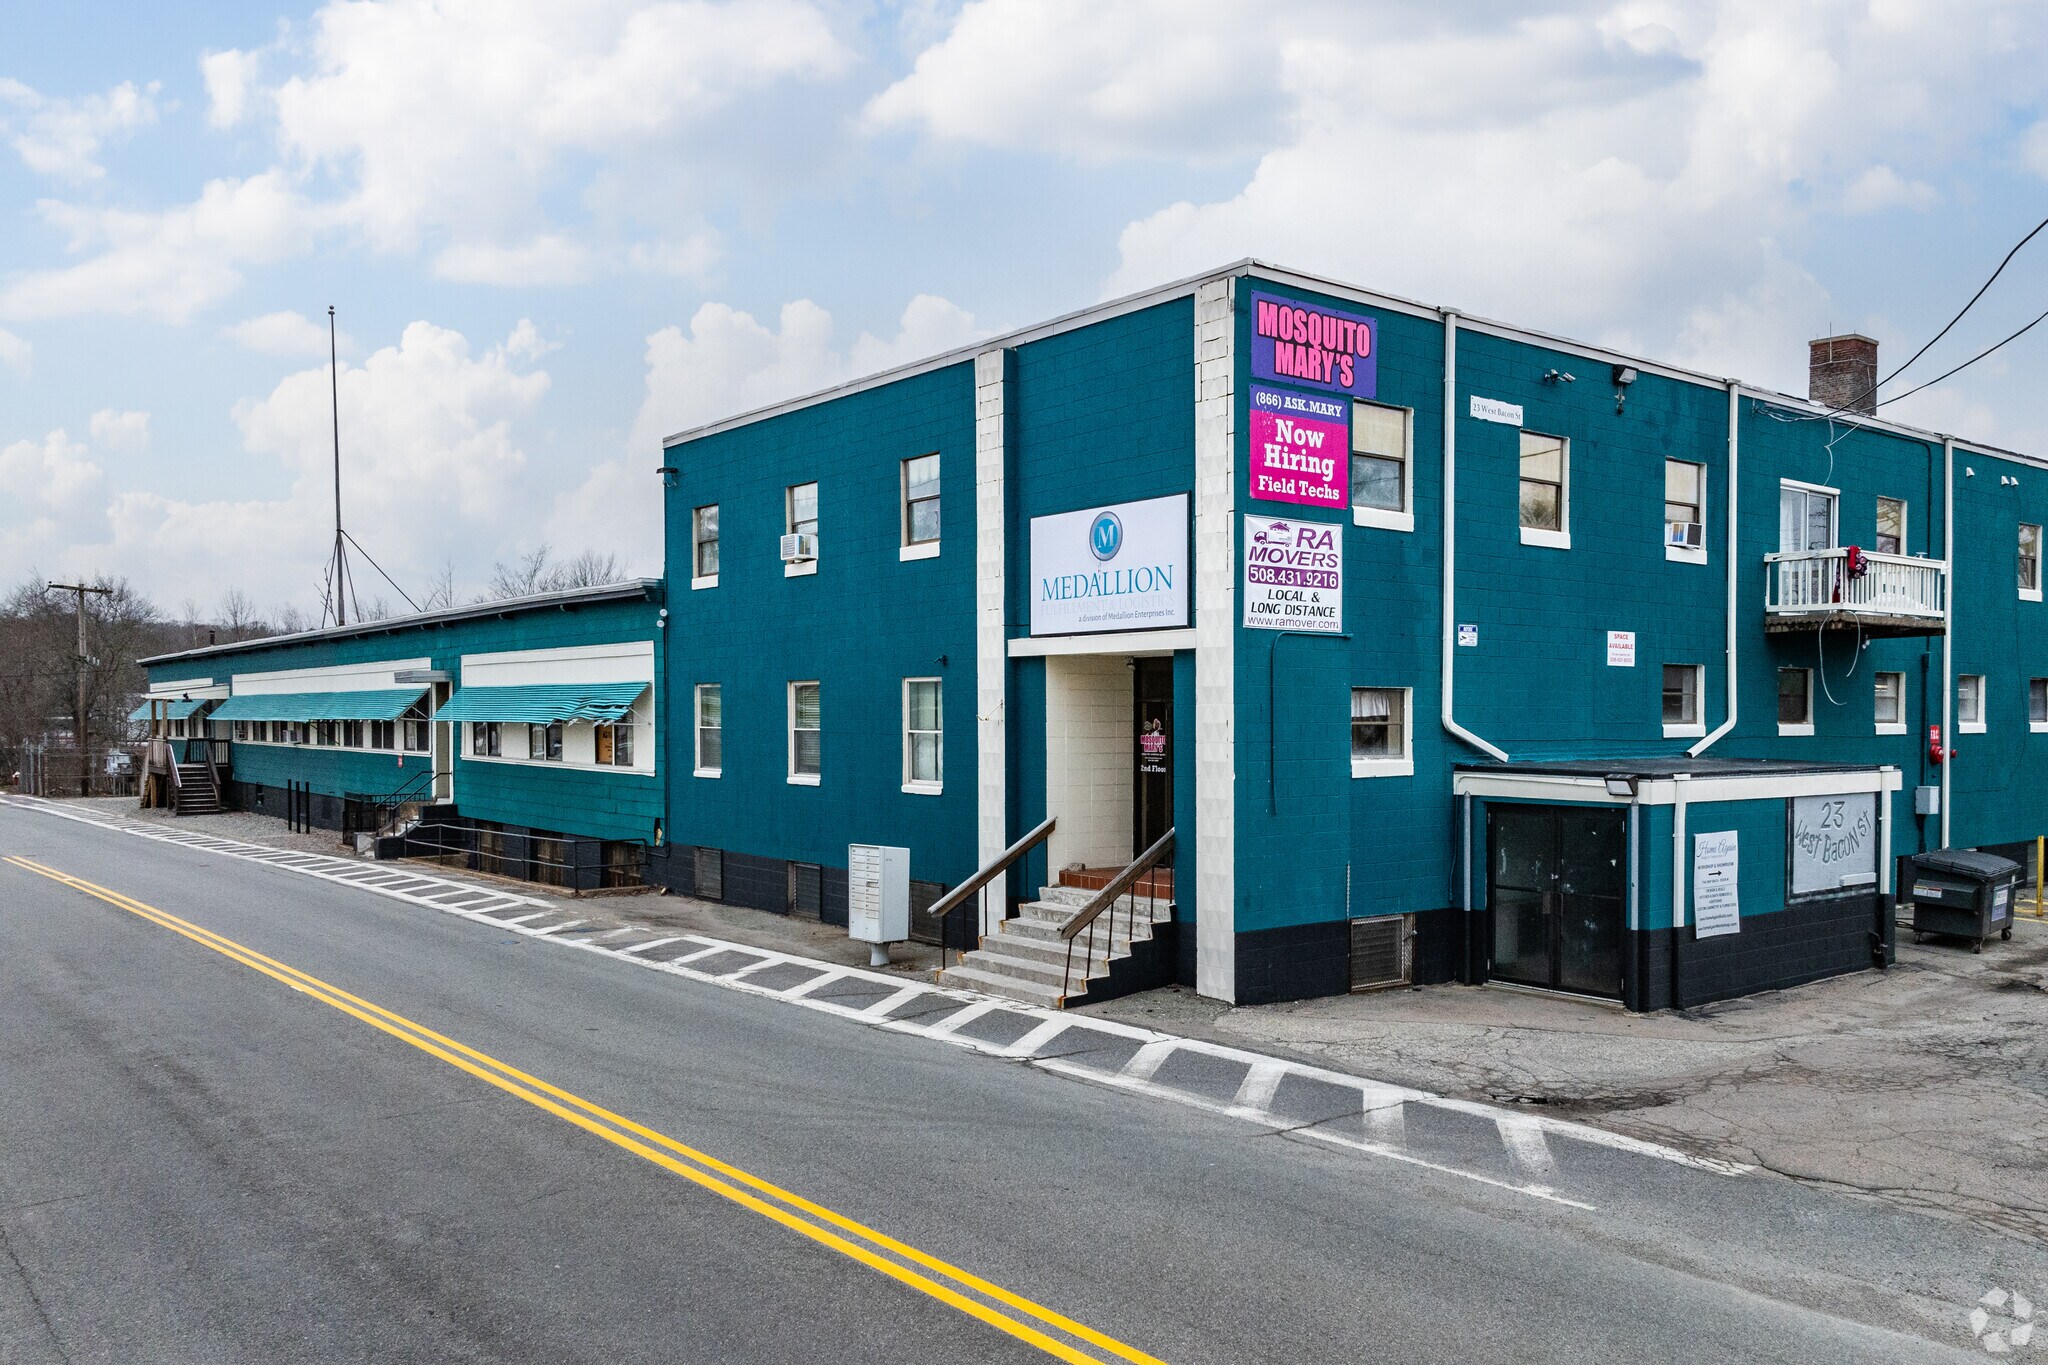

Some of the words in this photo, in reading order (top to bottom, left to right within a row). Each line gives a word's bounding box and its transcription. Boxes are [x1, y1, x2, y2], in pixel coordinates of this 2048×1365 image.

[1258, 300, 1371, 358] MOSQUITO
[1274, 340, 1355, 388] MARY'S
[1256, 392, 1282, 408] (866)
[1284, 396, 1342, 418] ASK.MARY
[1473, 404, 1480, 412] 23
[1482, 405, 1496, 415] West
[1498, 408, 1514, 418] Bacon
[1275, 418, 1325, 448] Now
[1264, 444, 1334, 482] Hiring
[1258, 475, 1296, 494] Field
[1299, 480, 1340, 500] Techs
[1098, 524, 1115, 549] M
[1296, 528, 1334, 550] RA
[1248, 546, 1338, 568] MOVERS
[1041, 564, 1174, 602] MEDALLION
[1250, 567, 1338, 588] 508.431.9216
[1268, 589, 1306, 602] LOCAL
[1311, 592, 1320, 603] &
[1083, 613, 1101, 622] division
[1108, 610, 1134, 620] Medallion
[1134, 609, 1164, 620] Enterprises
[1248, 616, 1338, 629] www.ramover.com
[1251, 602, 1281, 615] LONG
[1284, 604, 1336, 618] DISTANCE
[1820, 801, 1846, 829] 23
